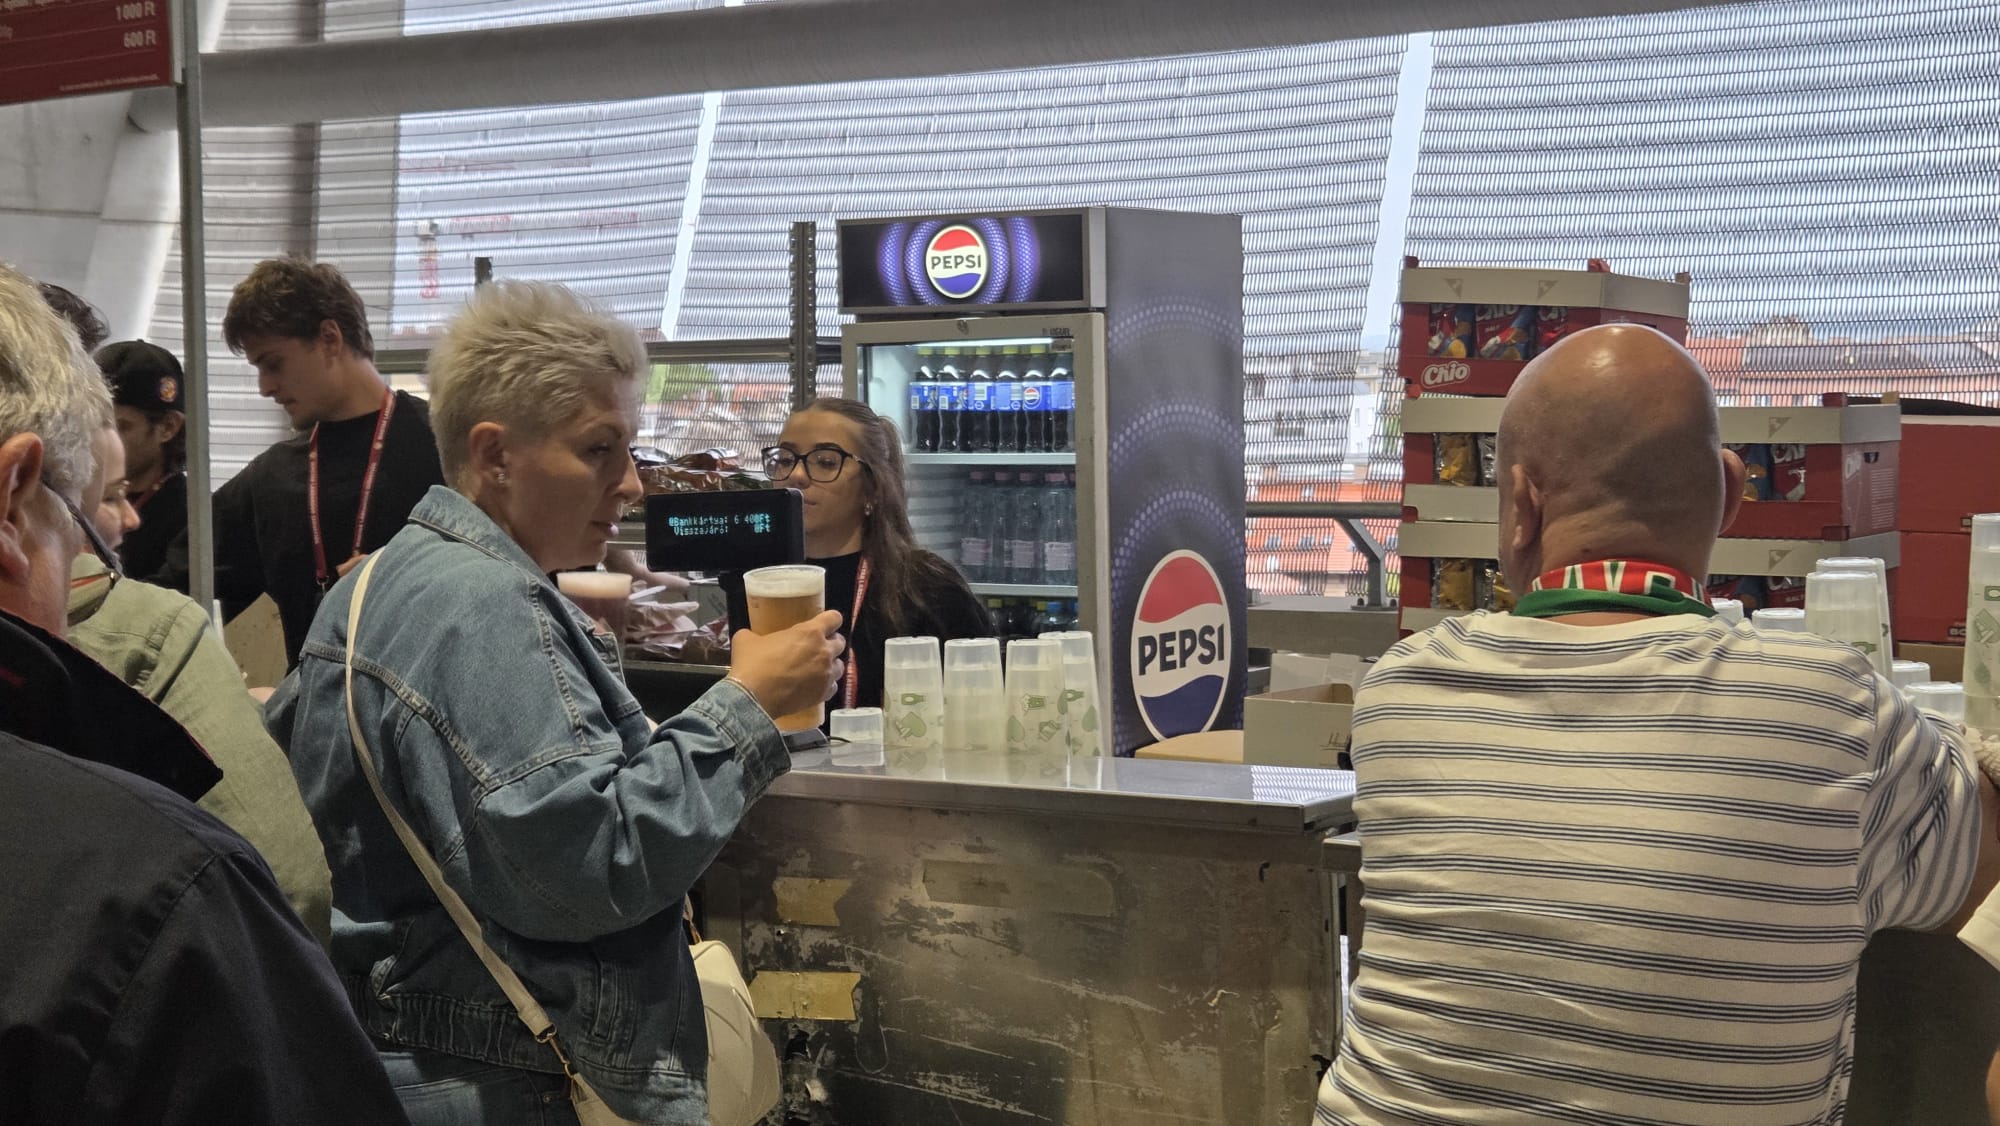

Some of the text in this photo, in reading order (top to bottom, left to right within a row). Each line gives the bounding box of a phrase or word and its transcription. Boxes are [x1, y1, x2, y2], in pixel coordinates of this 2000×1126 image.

[144, 1, 156, 16] Ft
[123, 30, 157, 48] 600 Ft
[931, 254, 982, 270] PEPSI
[1424, 361, 1469, 385] Chio
[734, 514, 740, 525] 6
[1138, 623, 1225, 676] PEPSI
